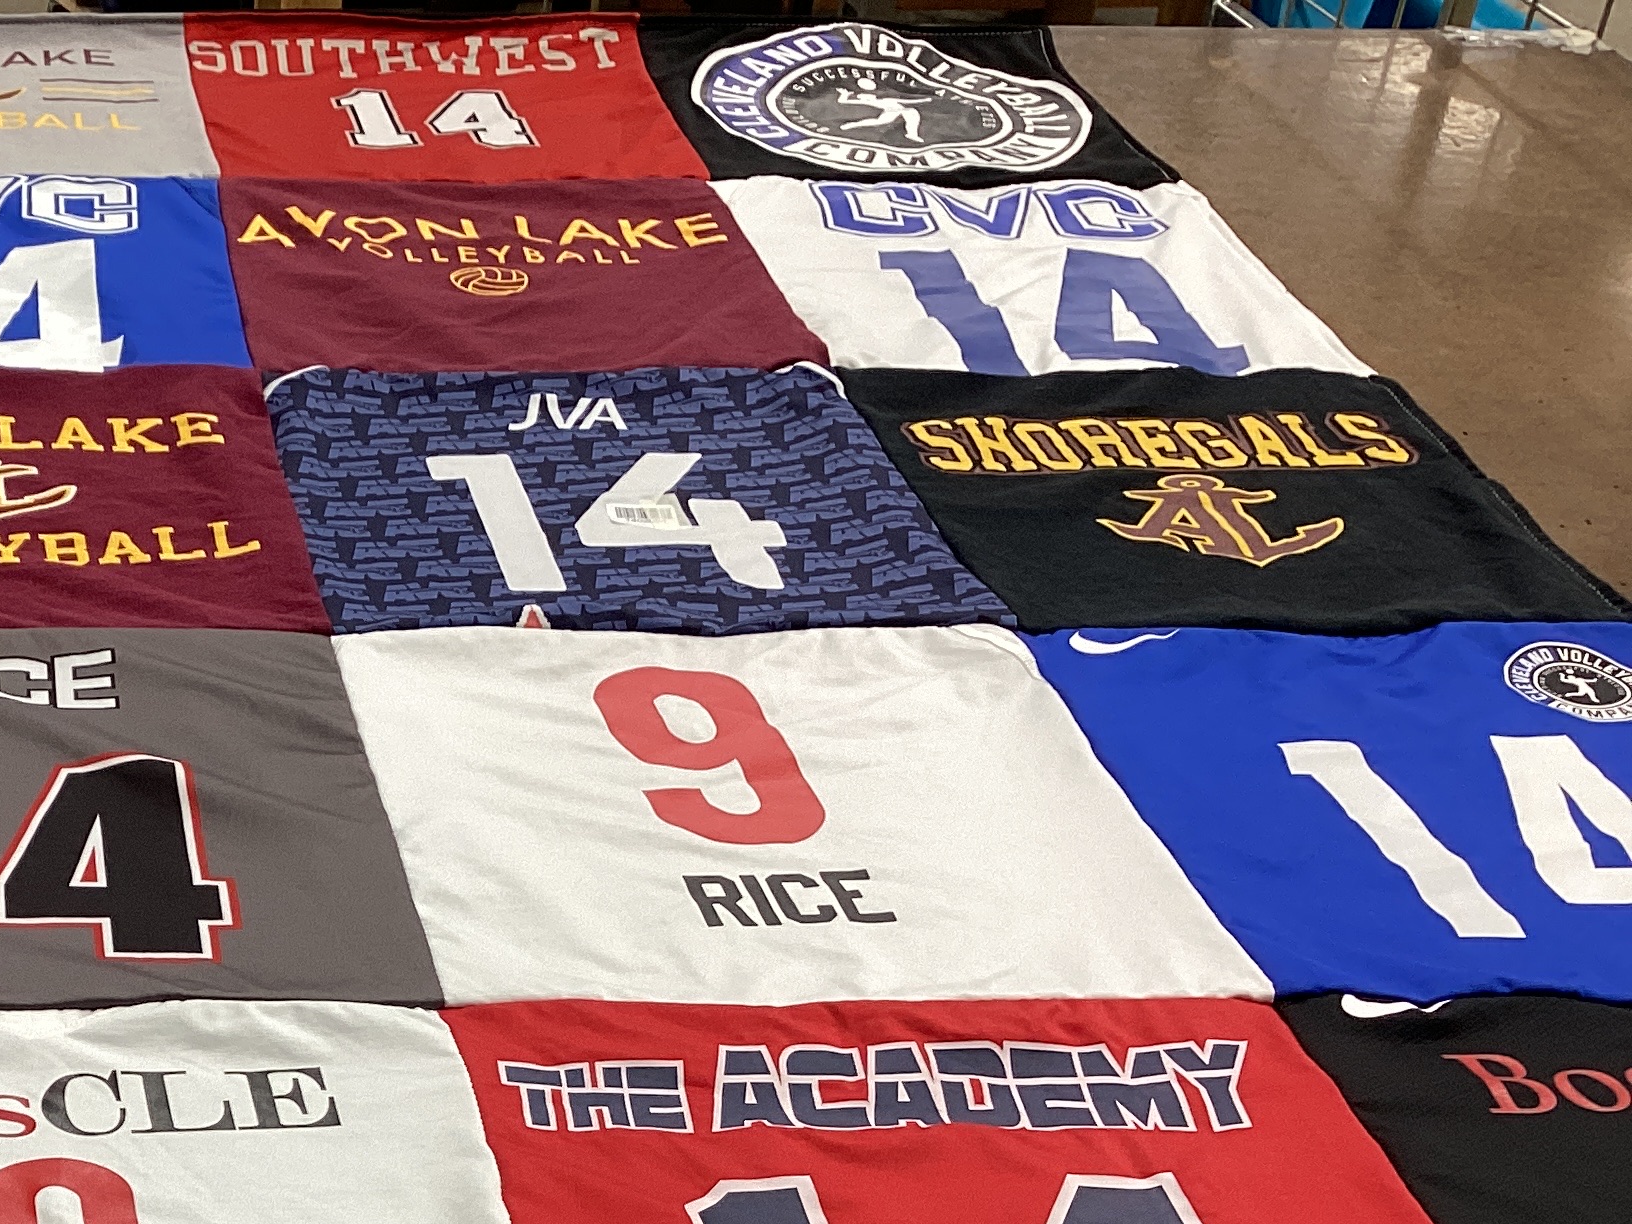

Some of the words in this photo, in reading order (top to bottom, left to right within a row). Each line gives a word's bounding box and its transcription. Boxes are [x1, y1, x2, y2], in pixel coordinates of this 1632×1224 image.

[187, 27, 620, 79] SOUTHWEST
[710, 34, 834, 140] CLEVELAND
[843, 28, 1073, 135] VOLLEYBALL
[330, 87, 540, 149] 14
[237, 204, 480, 249] AVON
[515, 212, 730, 250] LAKE
[808, 180, 1170, 242] CVC
[327, 236, 641, 265] VOLLEYBALL
[878, 247, 1251, 377] 14
[508, 392, 628, 432] JVA
[903, 412, 1419, 474] SHOREGALS
[425, 452, 787, 593] 14
[593, 666, 826, 844] 9
[682, 868, 897, 927] RICE
[496, 1059, 695, 1135] THE
[712, 1038, 1254, 1133] ACADEMY
[1440, 1053, 1632, 1114] Bo
